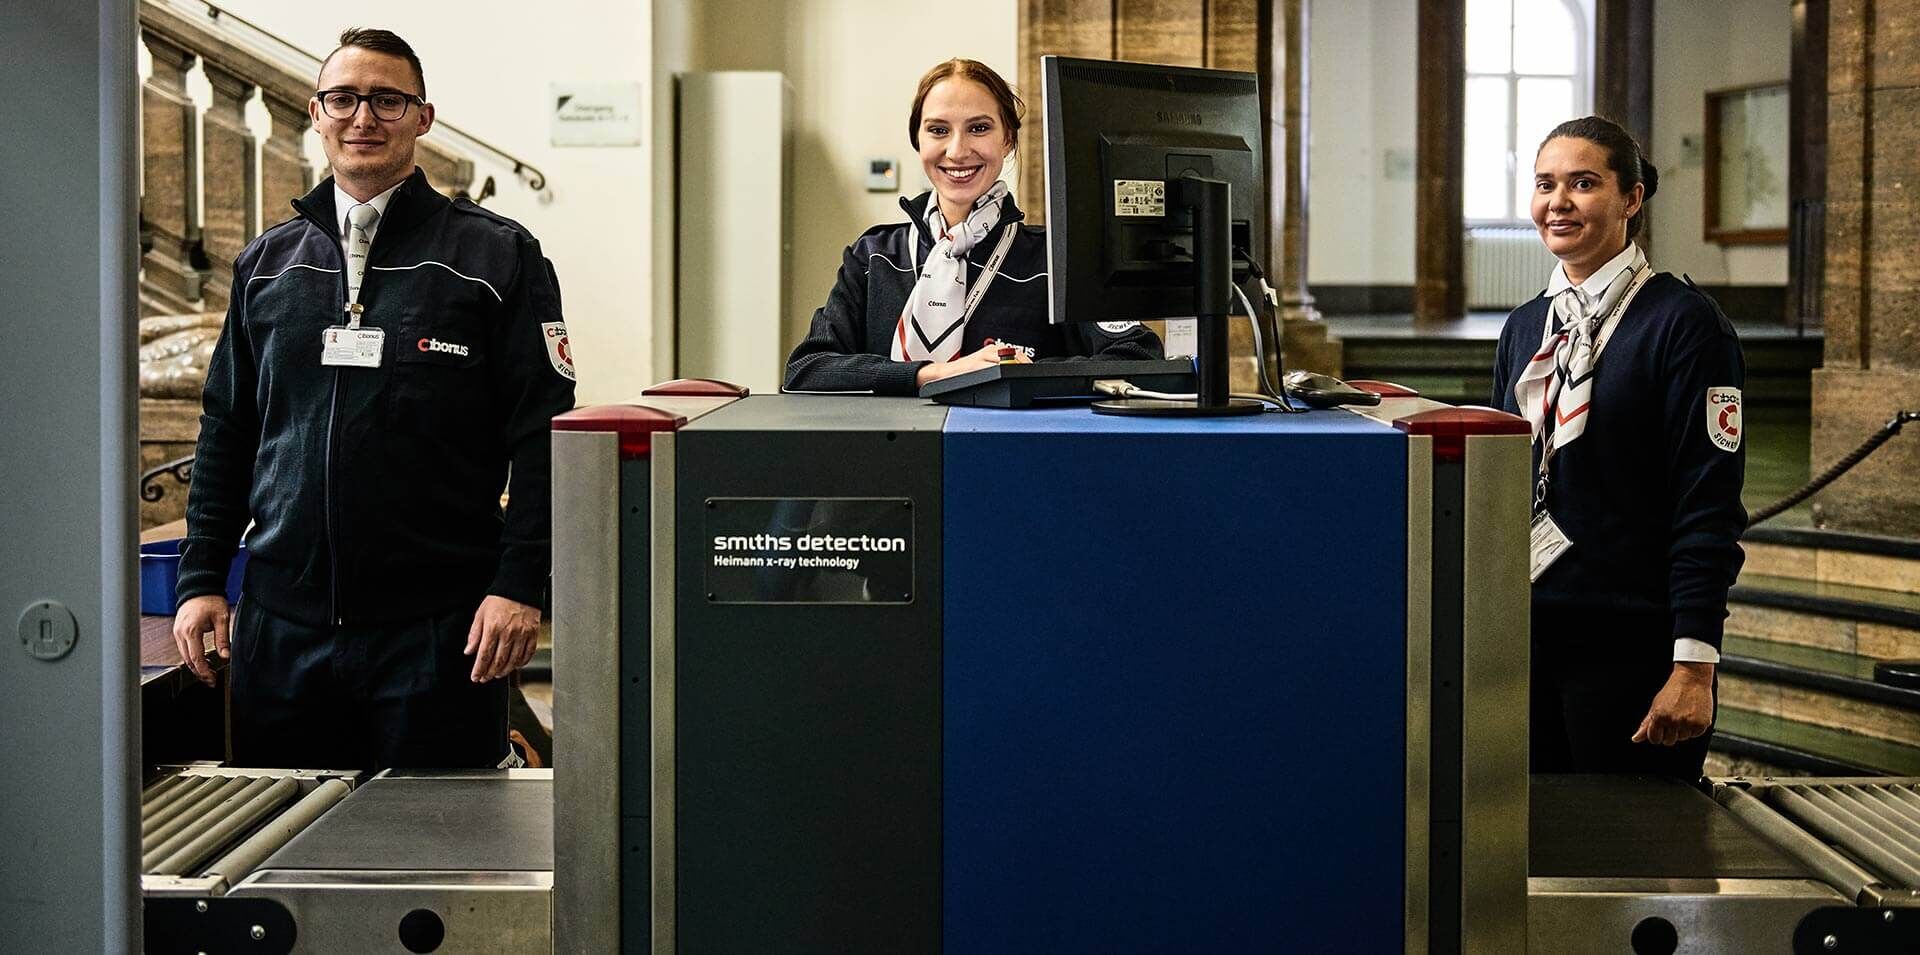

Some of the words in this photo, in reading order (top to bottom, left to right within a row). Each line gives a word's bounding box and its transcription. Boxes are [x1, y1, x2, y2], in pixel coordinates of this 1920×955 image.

[714, 555, 764, 567] Heimann
[766, 556, 797, 569] x-ray
[798, 555, 860, 570] technology
